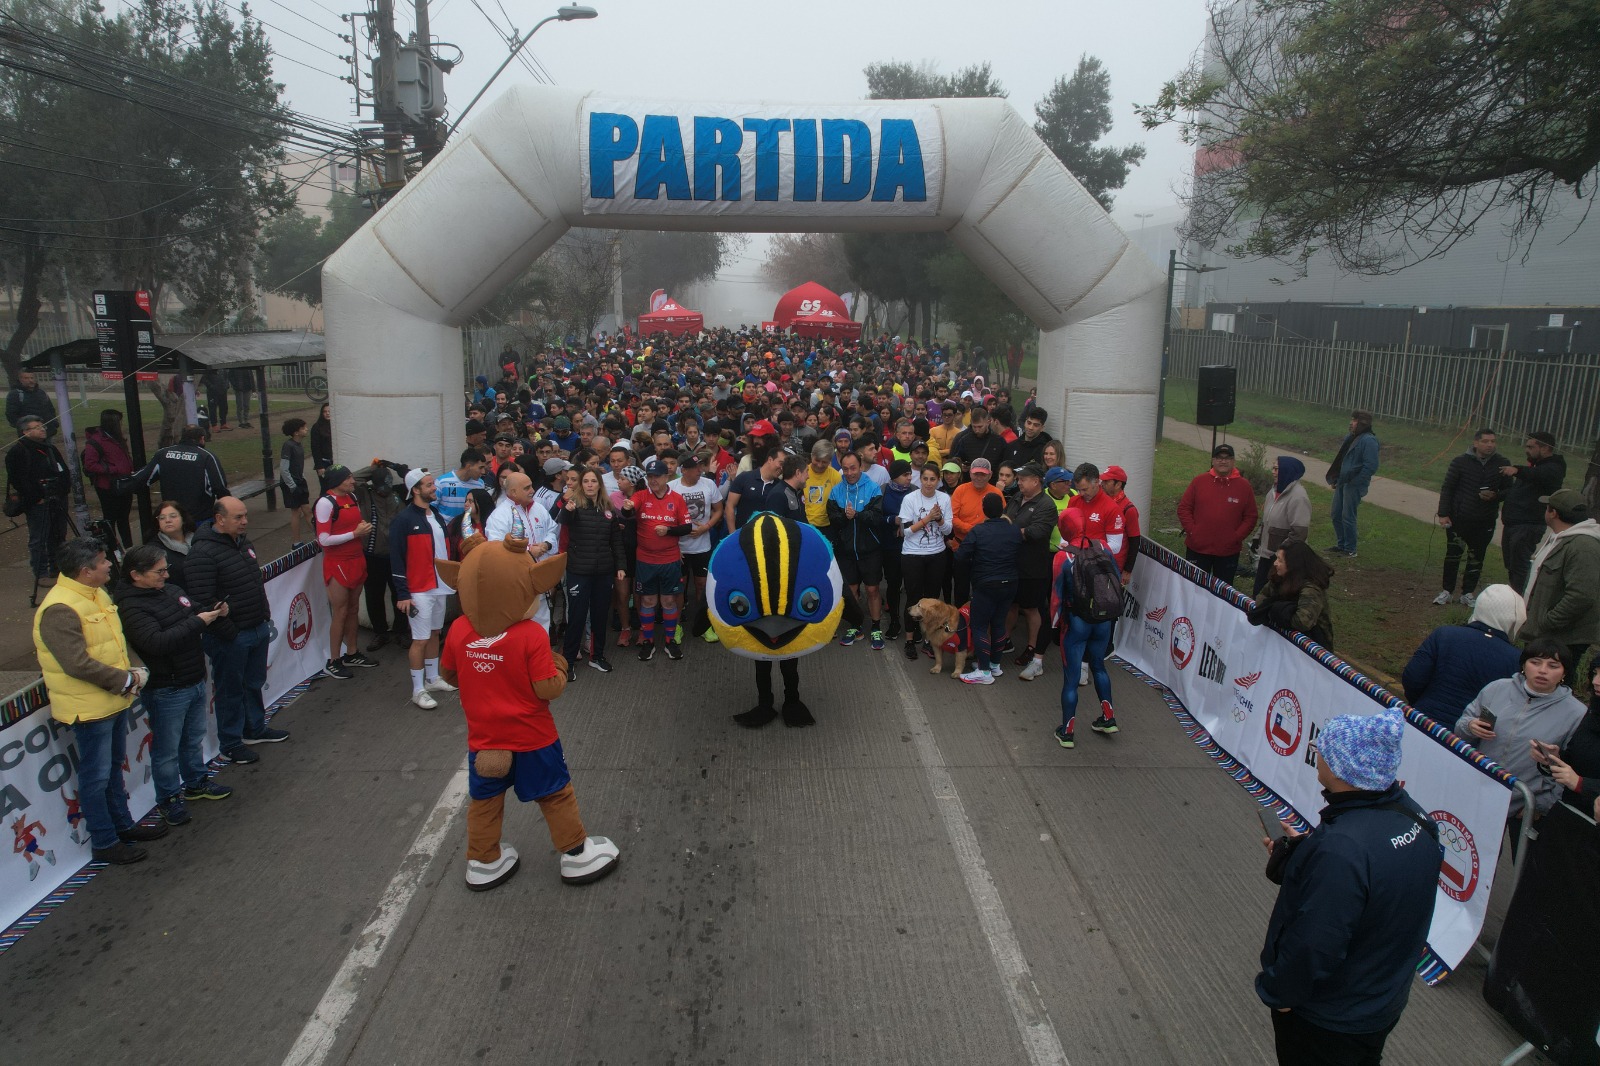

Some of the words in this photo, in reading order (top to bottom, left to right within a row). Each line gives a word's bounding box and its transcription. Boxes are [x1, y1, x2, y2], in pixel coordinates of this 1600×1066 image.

[589, 111, 927, 202] PARTIDA
[800, 299, 822, 312] GS
[448, 486, 457, 497] 14
[465, 650, 504, 662] TEAMCHILE
[1440, 882, 1461, 900] HILE
